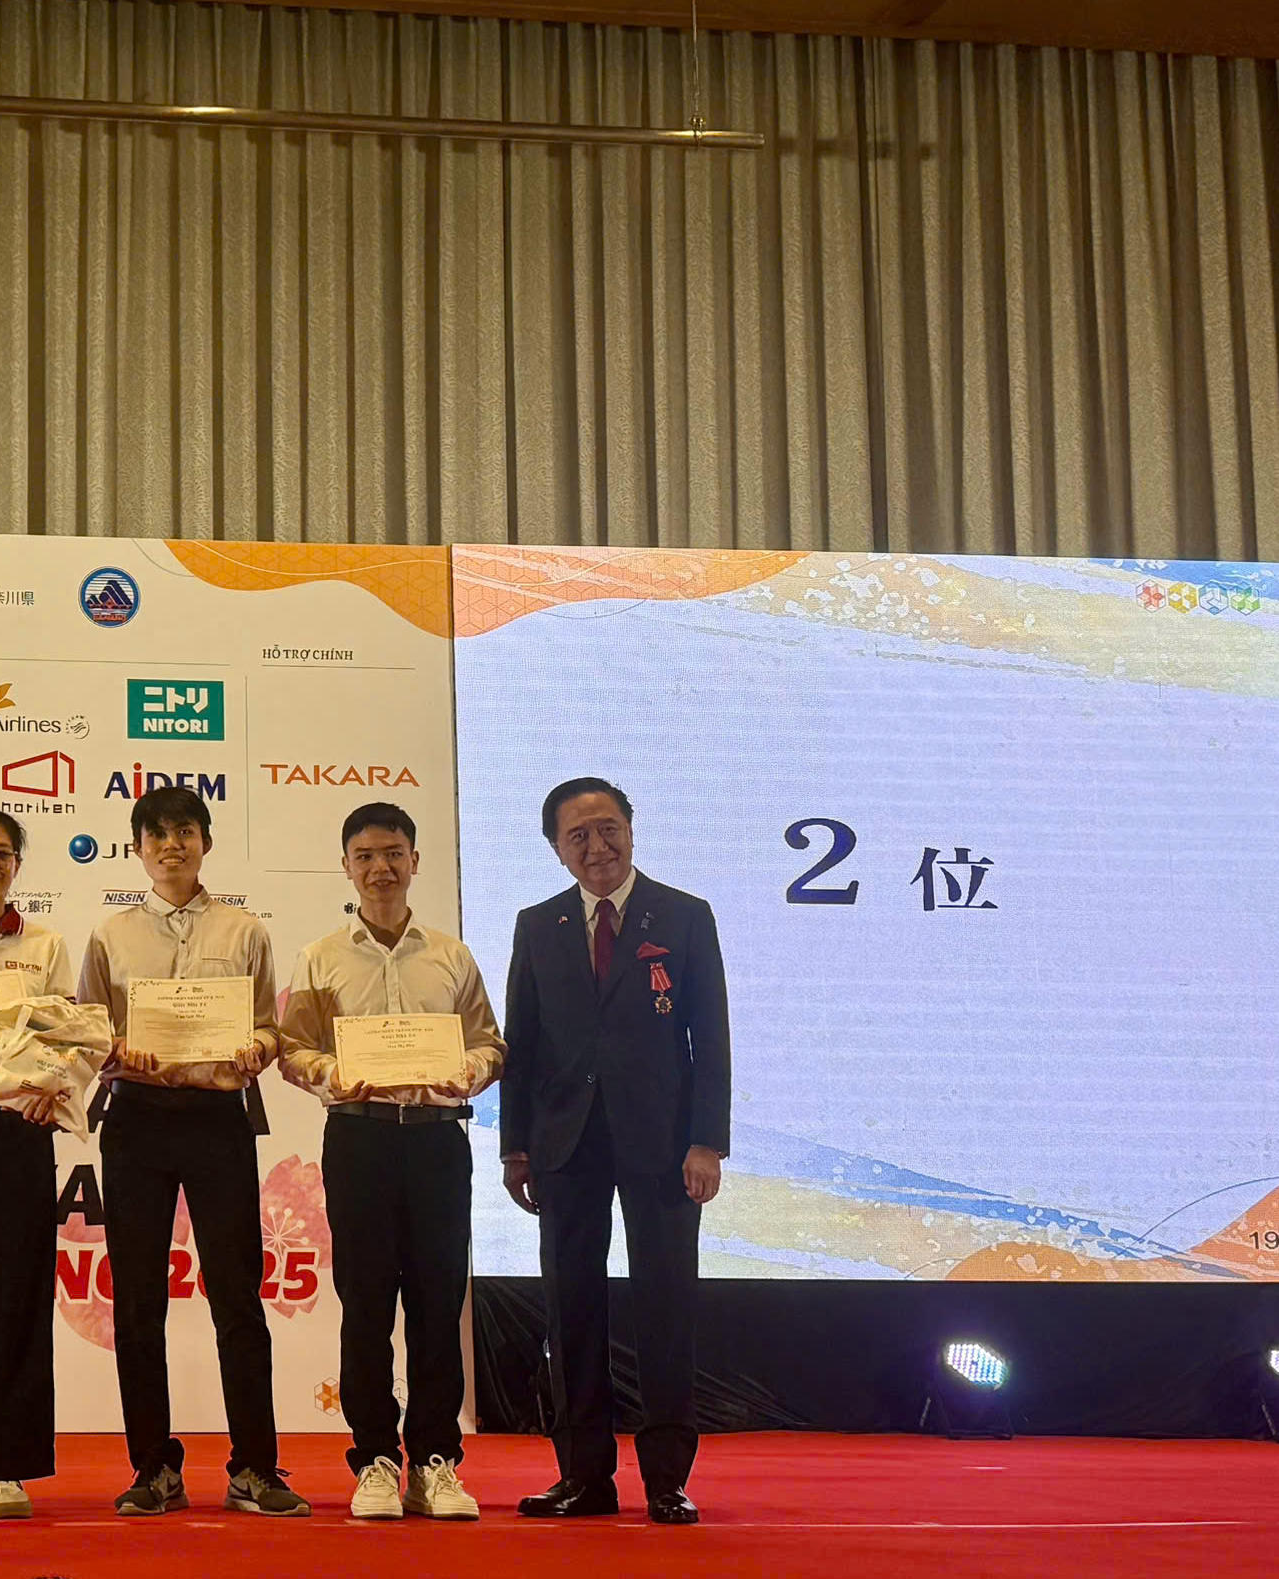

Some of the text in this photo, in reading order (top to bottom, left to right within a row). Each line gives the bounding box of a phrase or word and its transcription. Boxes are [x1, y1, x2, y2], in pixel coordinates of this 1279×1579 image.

[282, 649, 311, 661] TRỢ
[312, 648, 353, 660] CHÍNH
[143, 686, 209, 714] ニトリ
[143, 718, 209, 733] NITORI
[260, 764, 420, 787] TAKARA
[2, 798, 75, 814] noriken
[784, 817, 998, 912] 2 位
[104, 892, 146, 903] NISSIN
[12, 900, 53, 913] し銀行
[1249, 1231, 1279, 1250] 19
